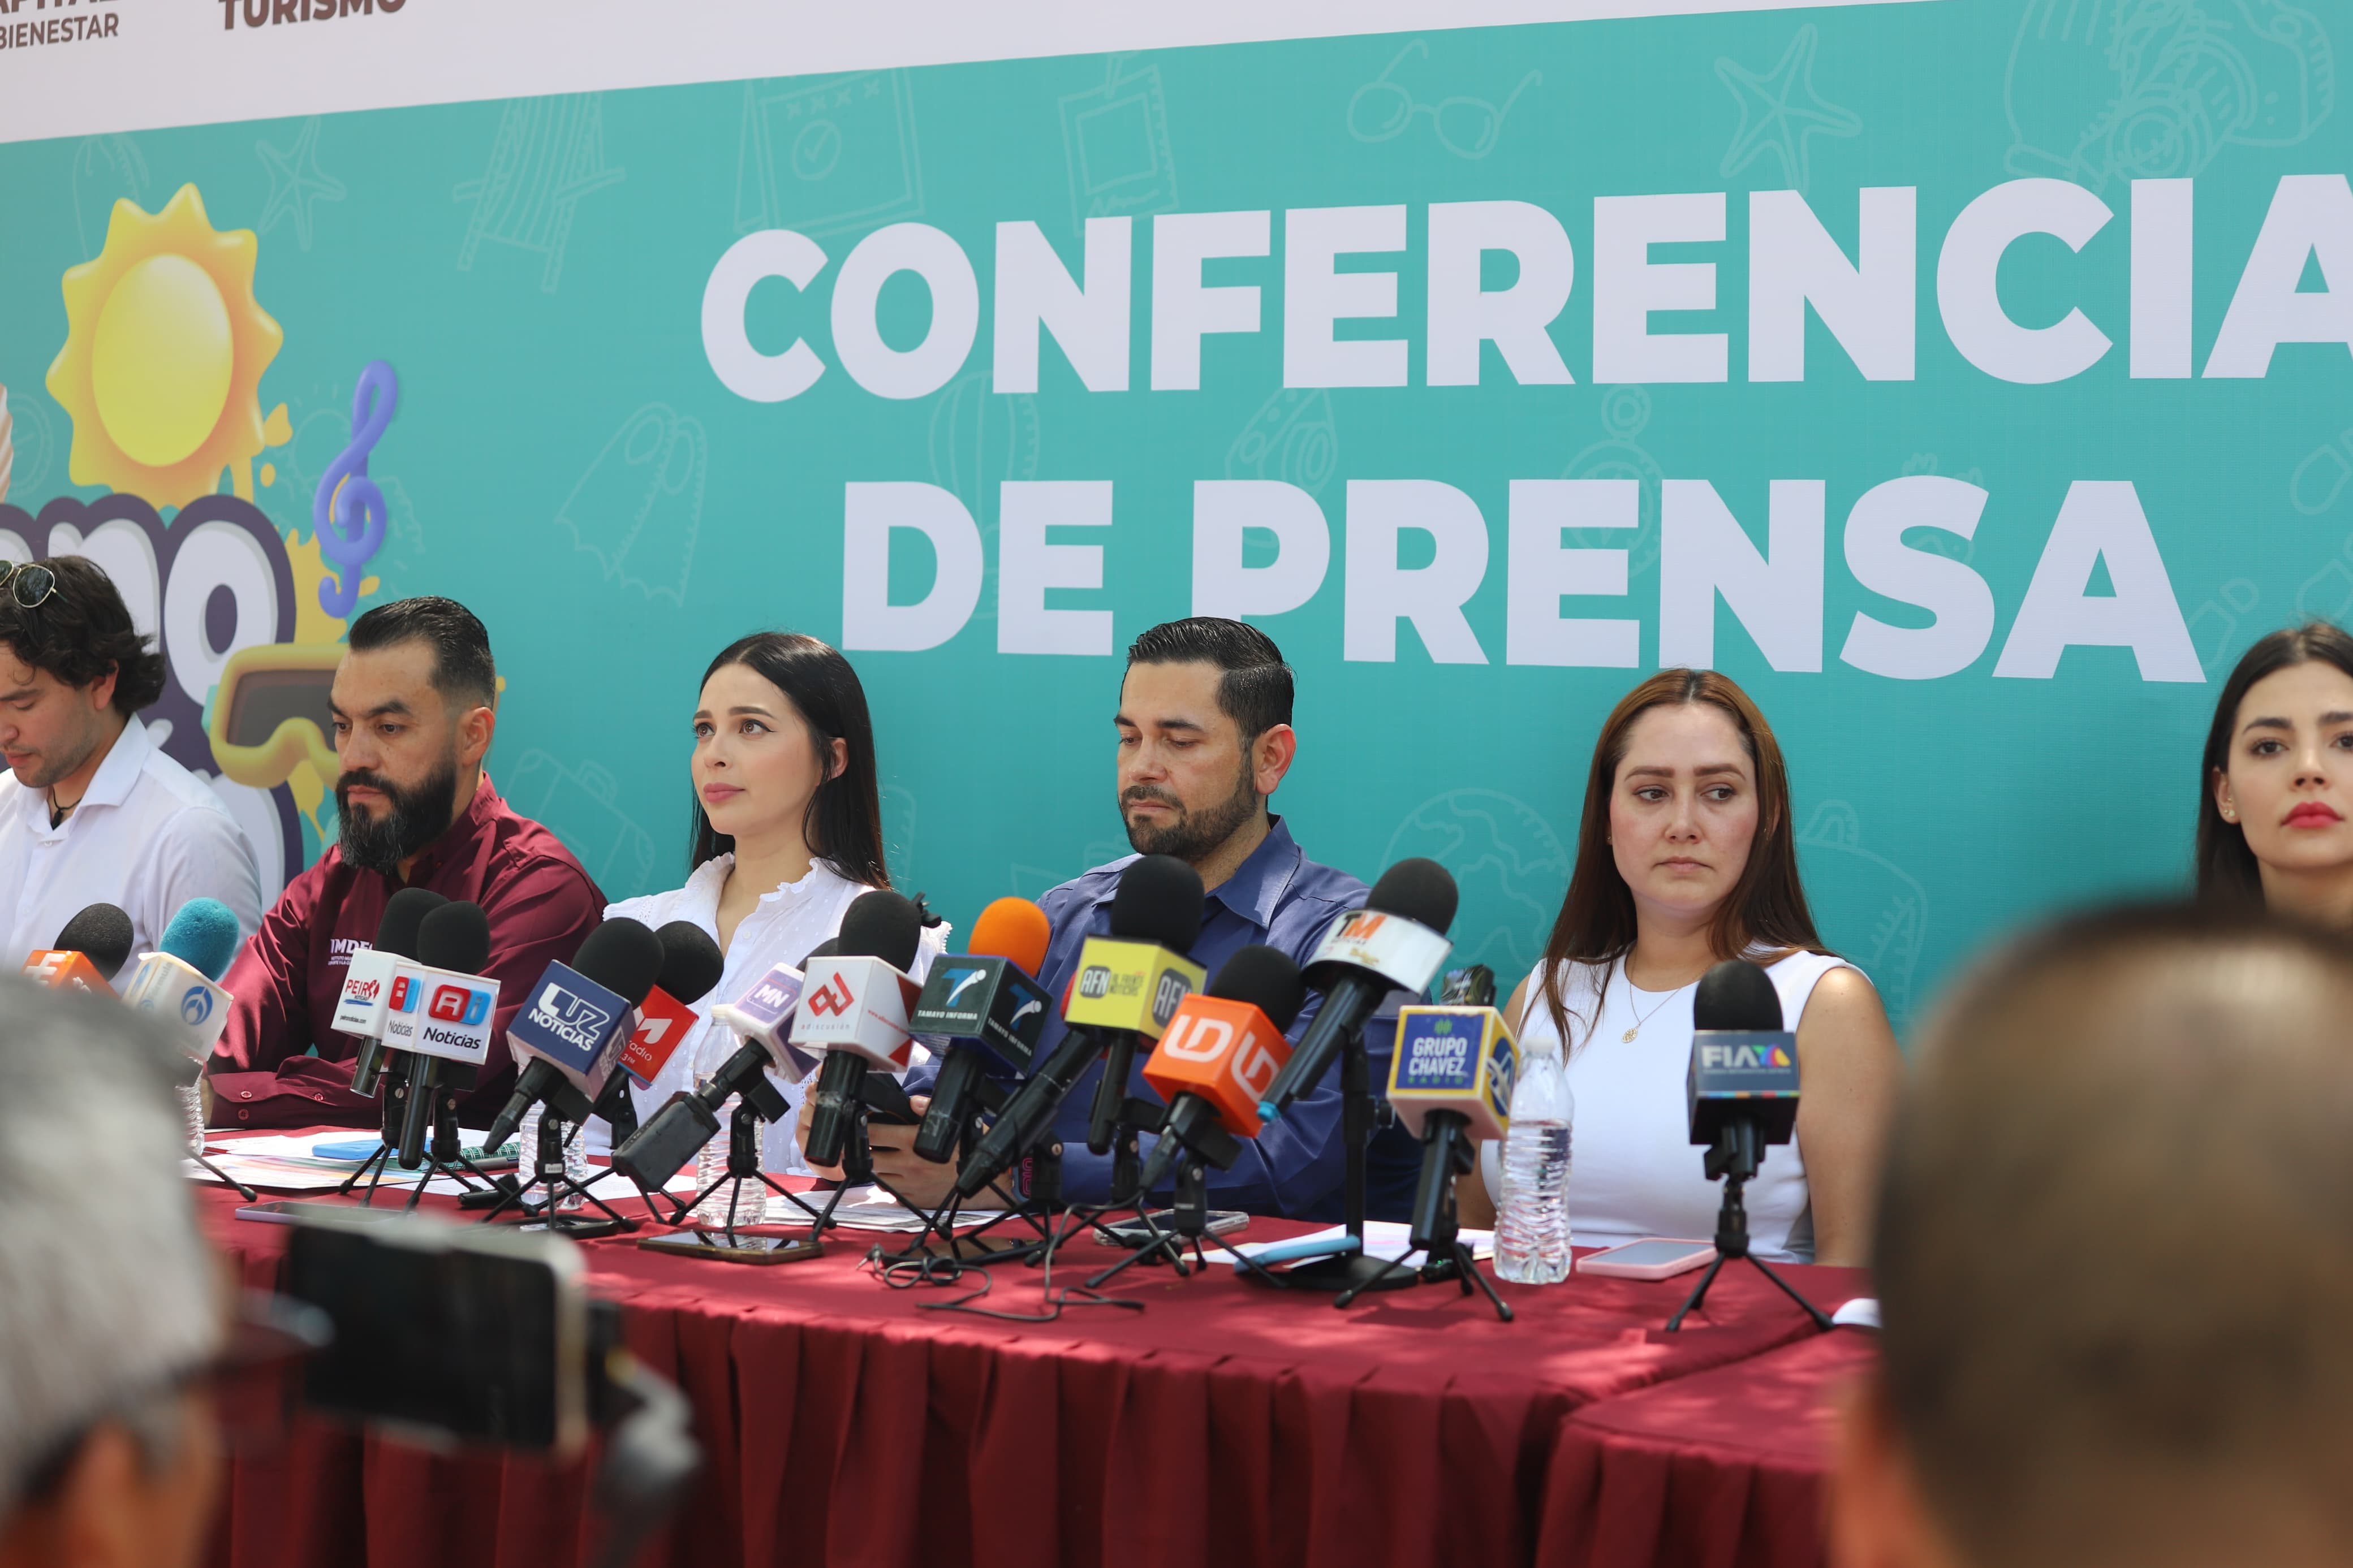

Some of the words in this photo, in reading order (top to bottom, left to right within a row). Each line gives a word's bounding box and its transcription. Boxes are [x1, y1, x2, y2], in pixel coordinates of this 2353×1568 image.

[701, 174, 2353, 402] CONFERENCIA
[843, 481, 1113, 655] DE
[1192, 476, 2206, 682] PRENSA
[1080, 969, 1111, 995] AFN
[754, 984, 790, 1008] MN
[538, 982, 610, 1040] LUZ
[917, 1010, 945, 1018] TAMAYO
[946, 1012, 977, 1020] INFORMA
[387, 1020, 413, 1037] Noticias
[423, 1027, 481, 1049] Noticias
[528, 1008, 594, 1051] NOTICIAS
[988, 1017, 1009, 1038] TAMAYO
[1008, 1033, 1032, 1057] INFORMA
[628, 1040, 652, 1061] adio
[1412, 1037, 1467, 1057] GRUPO
[1408, 1057, 1469, 1077] CHAVEZ
